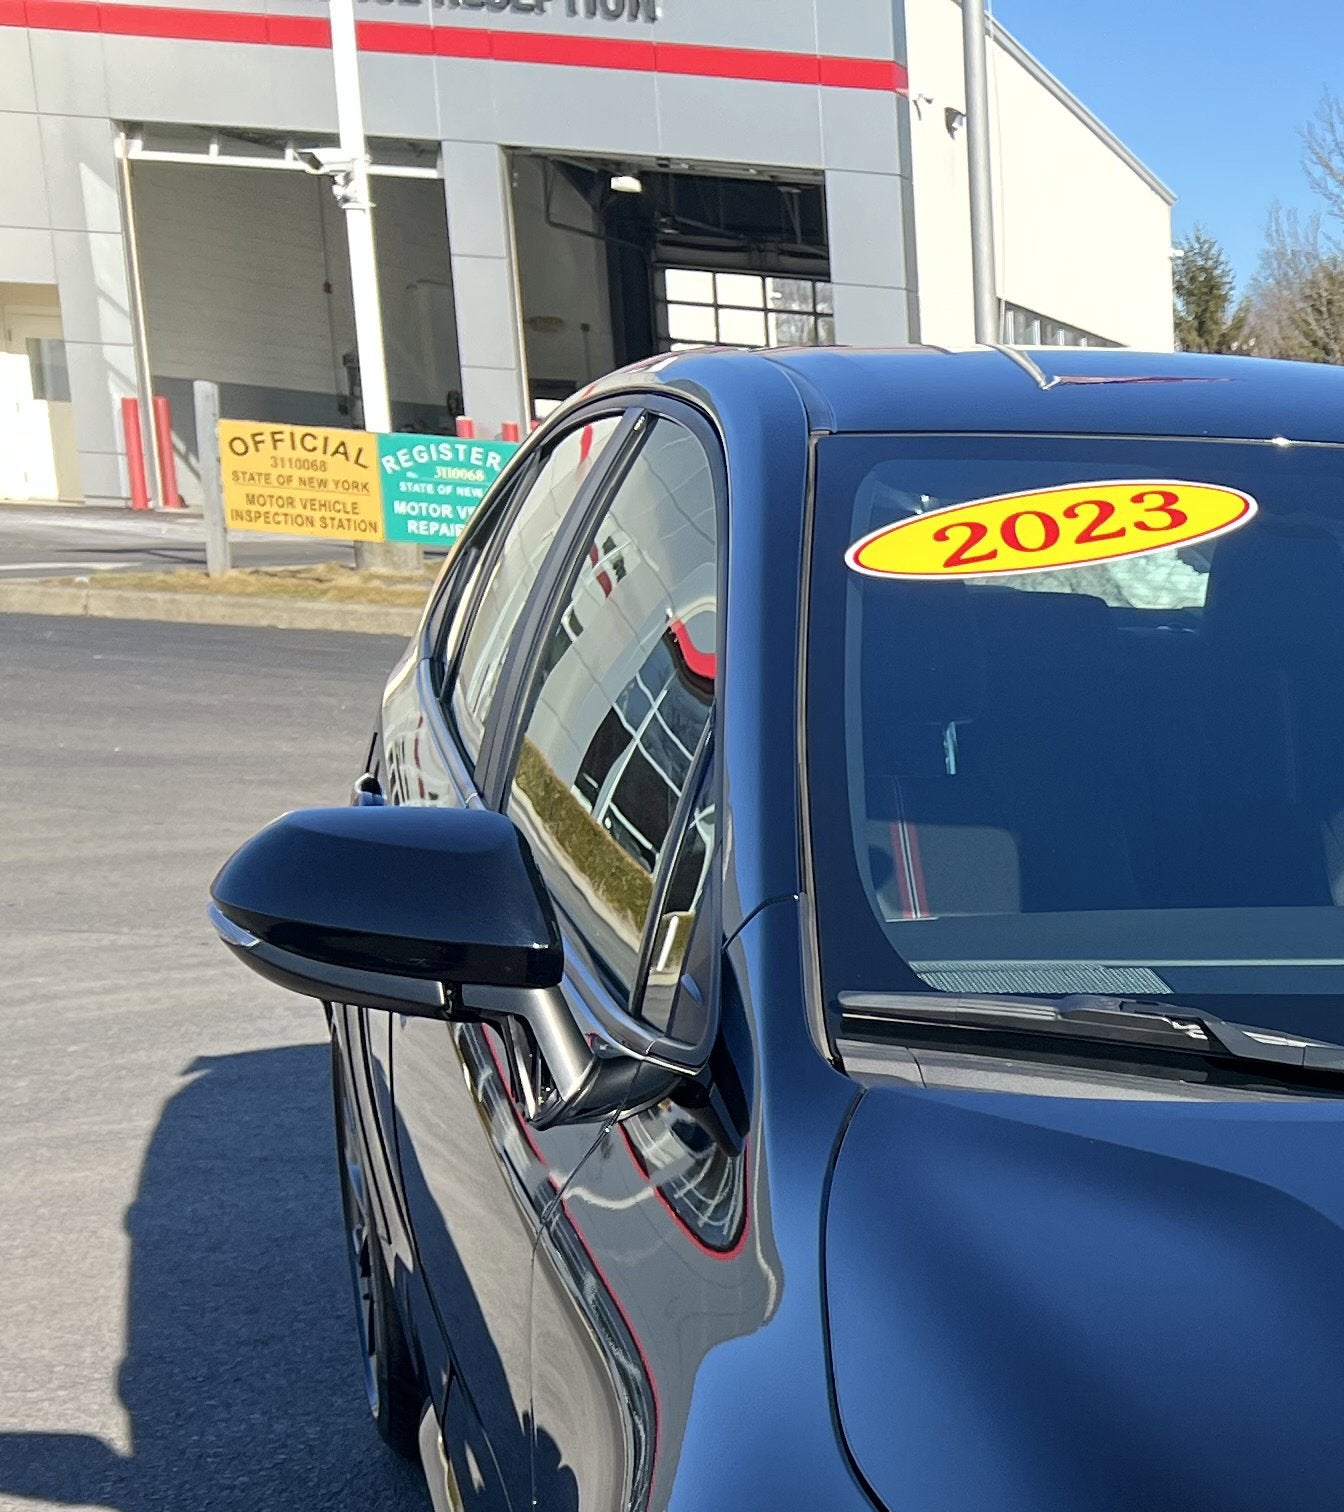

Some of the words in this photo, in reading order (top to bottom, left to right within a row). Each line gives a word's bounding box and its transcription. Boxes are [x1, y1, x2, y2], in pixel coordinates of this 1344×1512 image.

[229, 430, 369, 470] OFFICIAL
[270, 456, 327, 472] 3110068
[232, 471, 272, 485] STATE
[276, 474, 293, 486] OF
[298, 476, 327, 489] NEW
[333, 480, 370, 493] YORK
[399, 481, 434, 495] STATE
[437, 484, 452, 496] OF
[246, 493, 296, 509] MOTOR
[300, 498, 359, 515] VEHICLE
[394, 500, 453, 519] MOTOR
[230, 509, 315, 528] INSPECTION
[319, 516, 378, 534] STATION
[932, 490, 1188, 568] 2023
